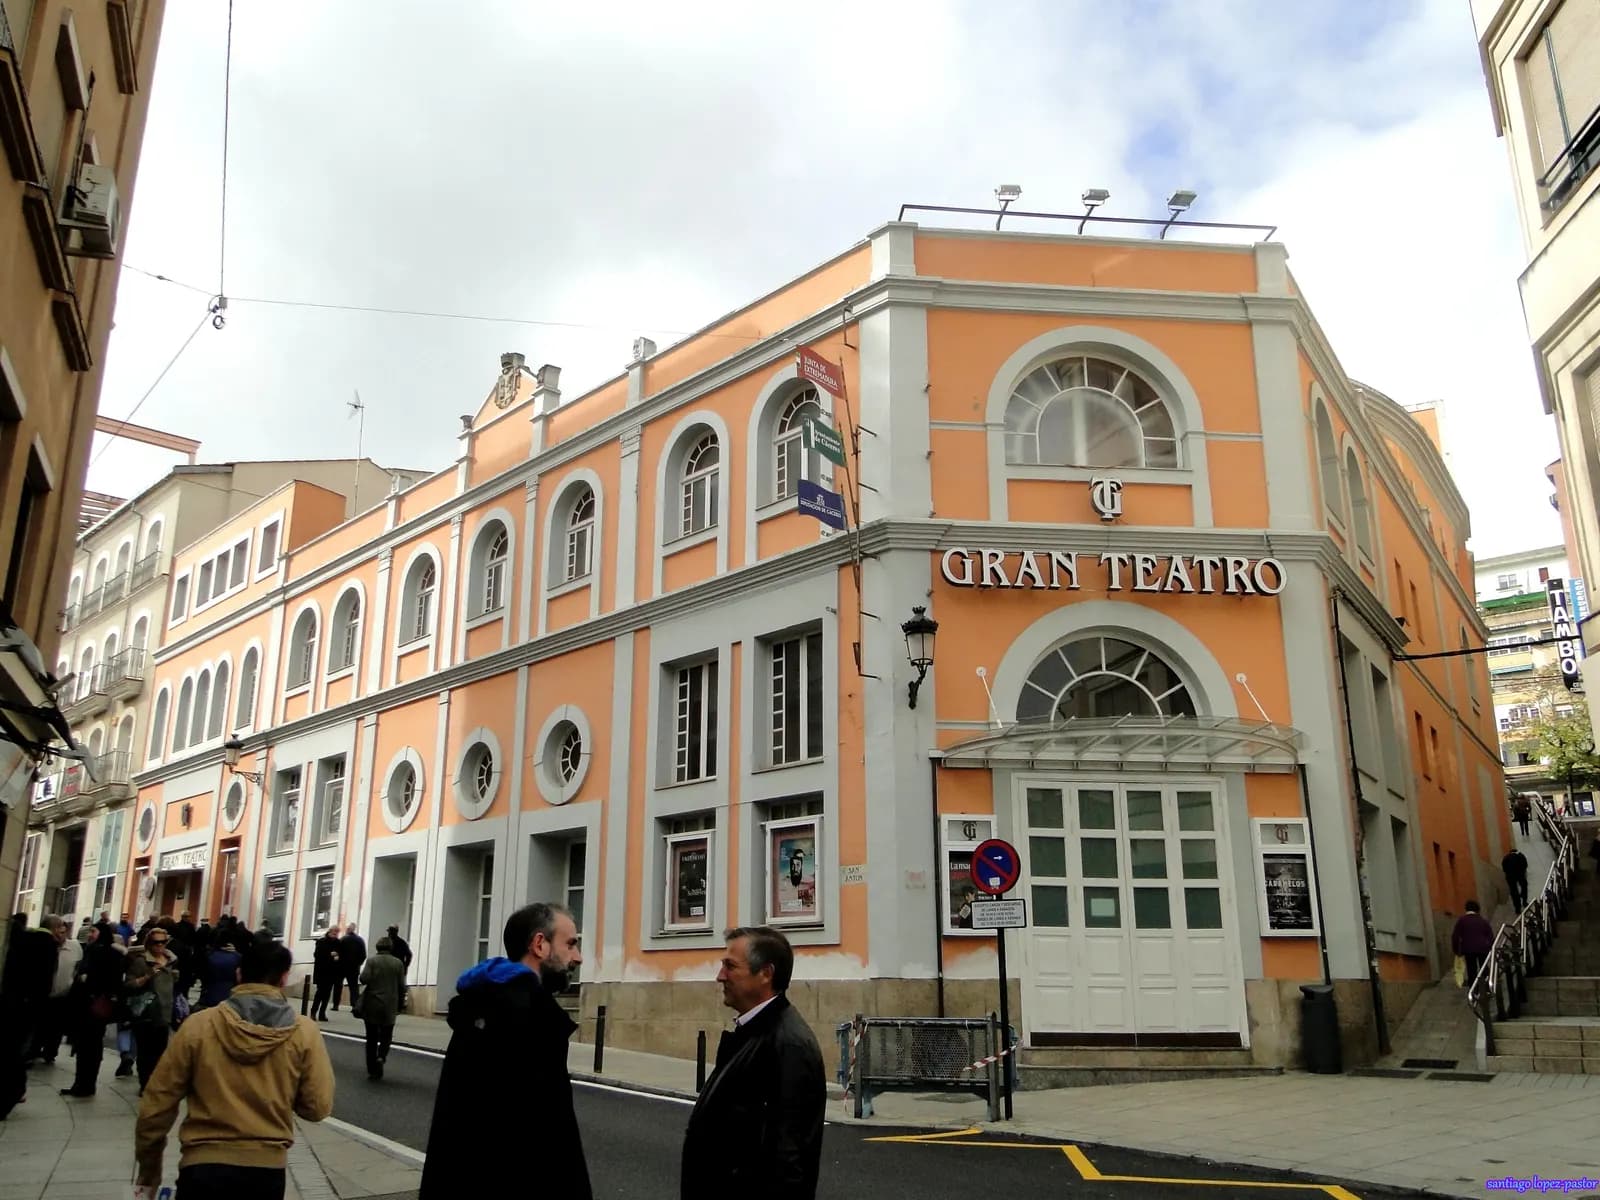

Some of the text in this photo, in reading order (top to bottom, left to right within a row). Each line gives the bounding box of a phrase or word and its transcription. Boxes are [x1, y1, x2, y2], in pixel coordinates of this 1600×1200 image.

[805, 356, 819, 369] JUNTA
[940, 547, 1288, 595] GRAN TEATRO
[1549, 590, 1577, 675] TAMBO
